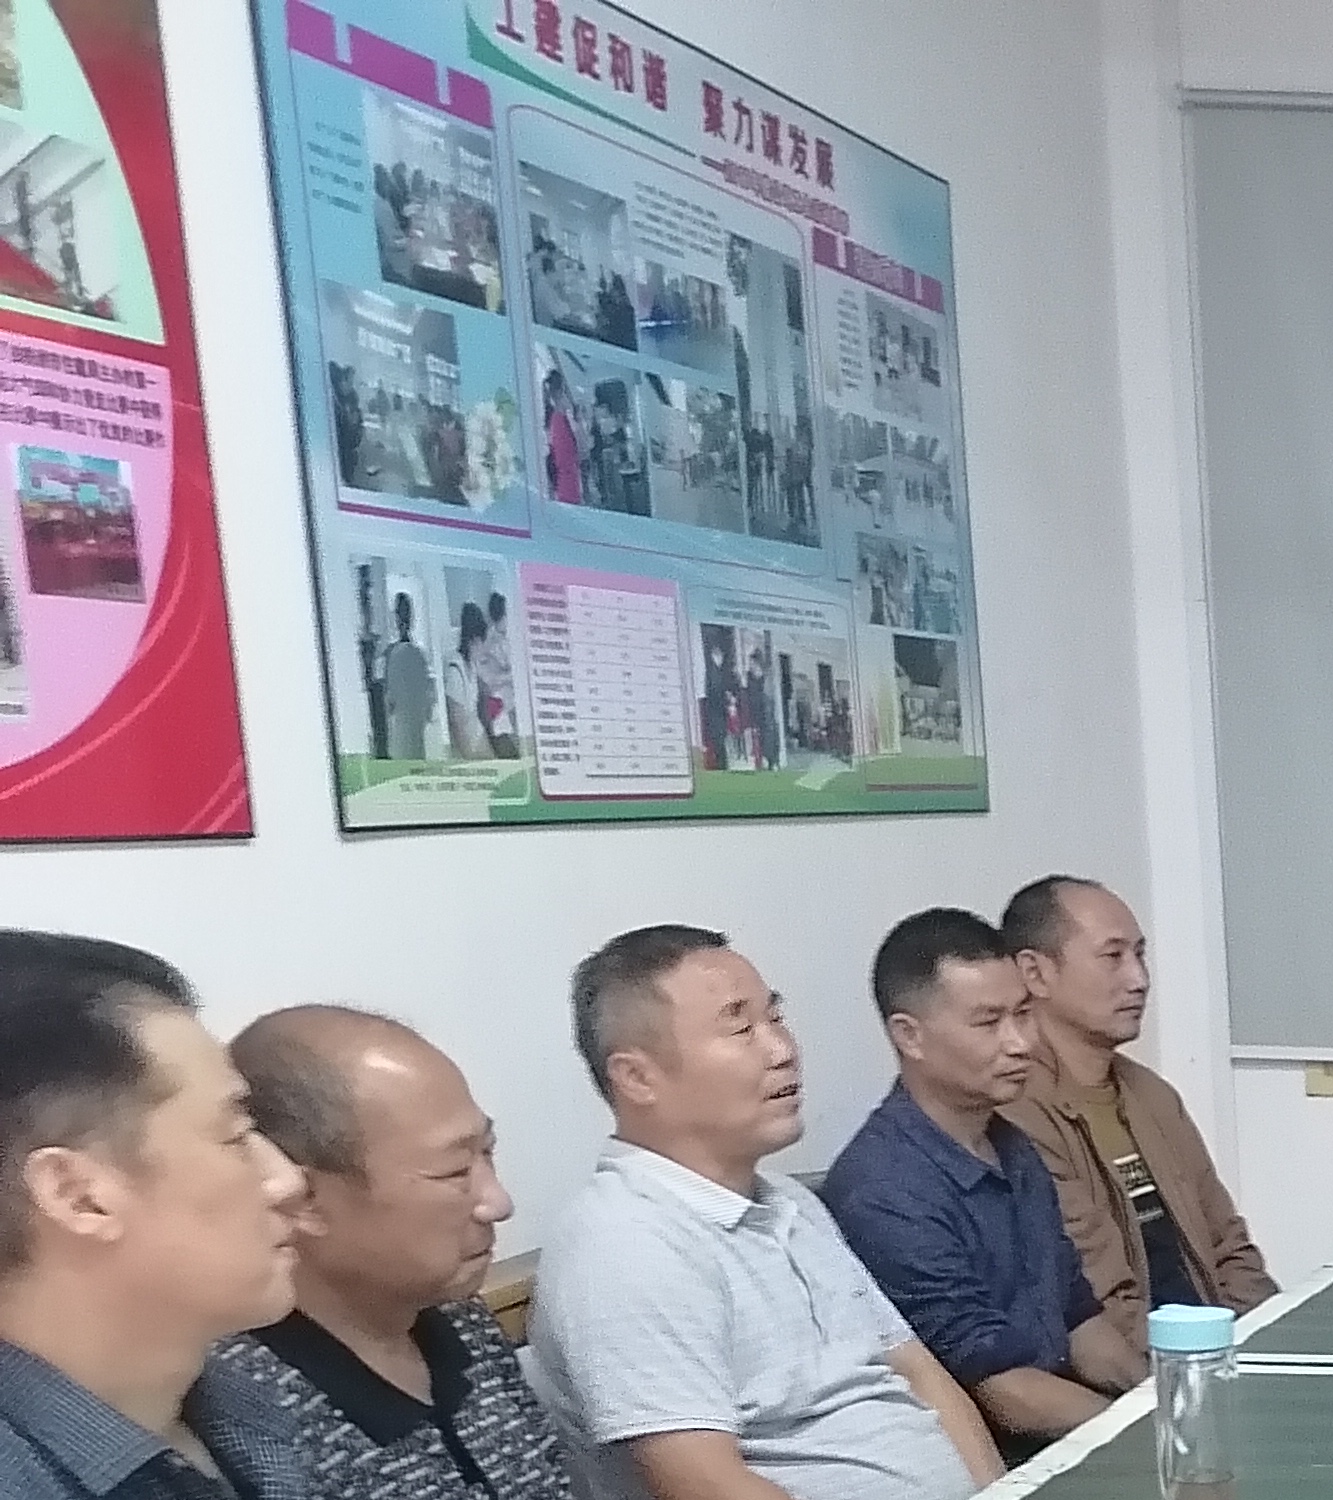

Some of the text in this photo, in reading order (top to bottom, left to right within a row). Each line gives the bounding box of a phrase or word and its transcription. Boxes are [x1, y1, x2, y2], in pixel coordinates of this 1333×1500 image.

[702, 80, 835, 193] 聚力谋发展
